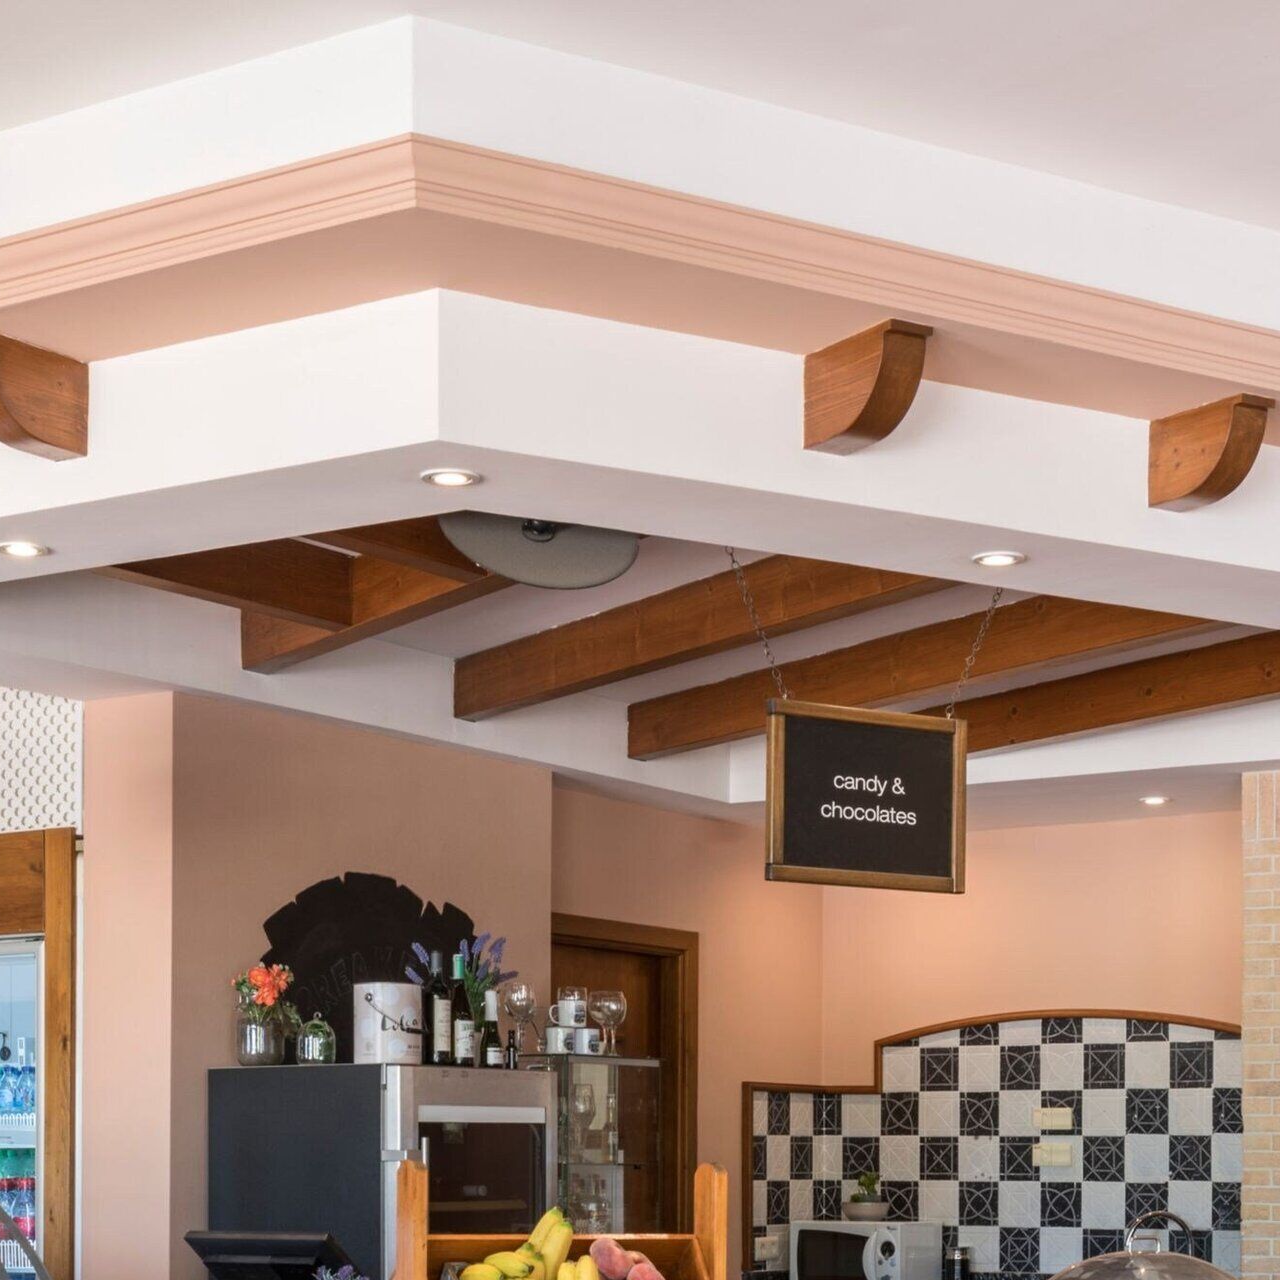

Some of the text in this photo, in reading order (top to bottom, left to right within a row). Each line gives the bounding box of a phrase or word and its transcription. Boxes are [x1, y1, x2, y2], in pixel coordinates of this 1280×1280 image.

[833, 773, 907, 798] candy &
[820, 800, 918, 826] chocolates
